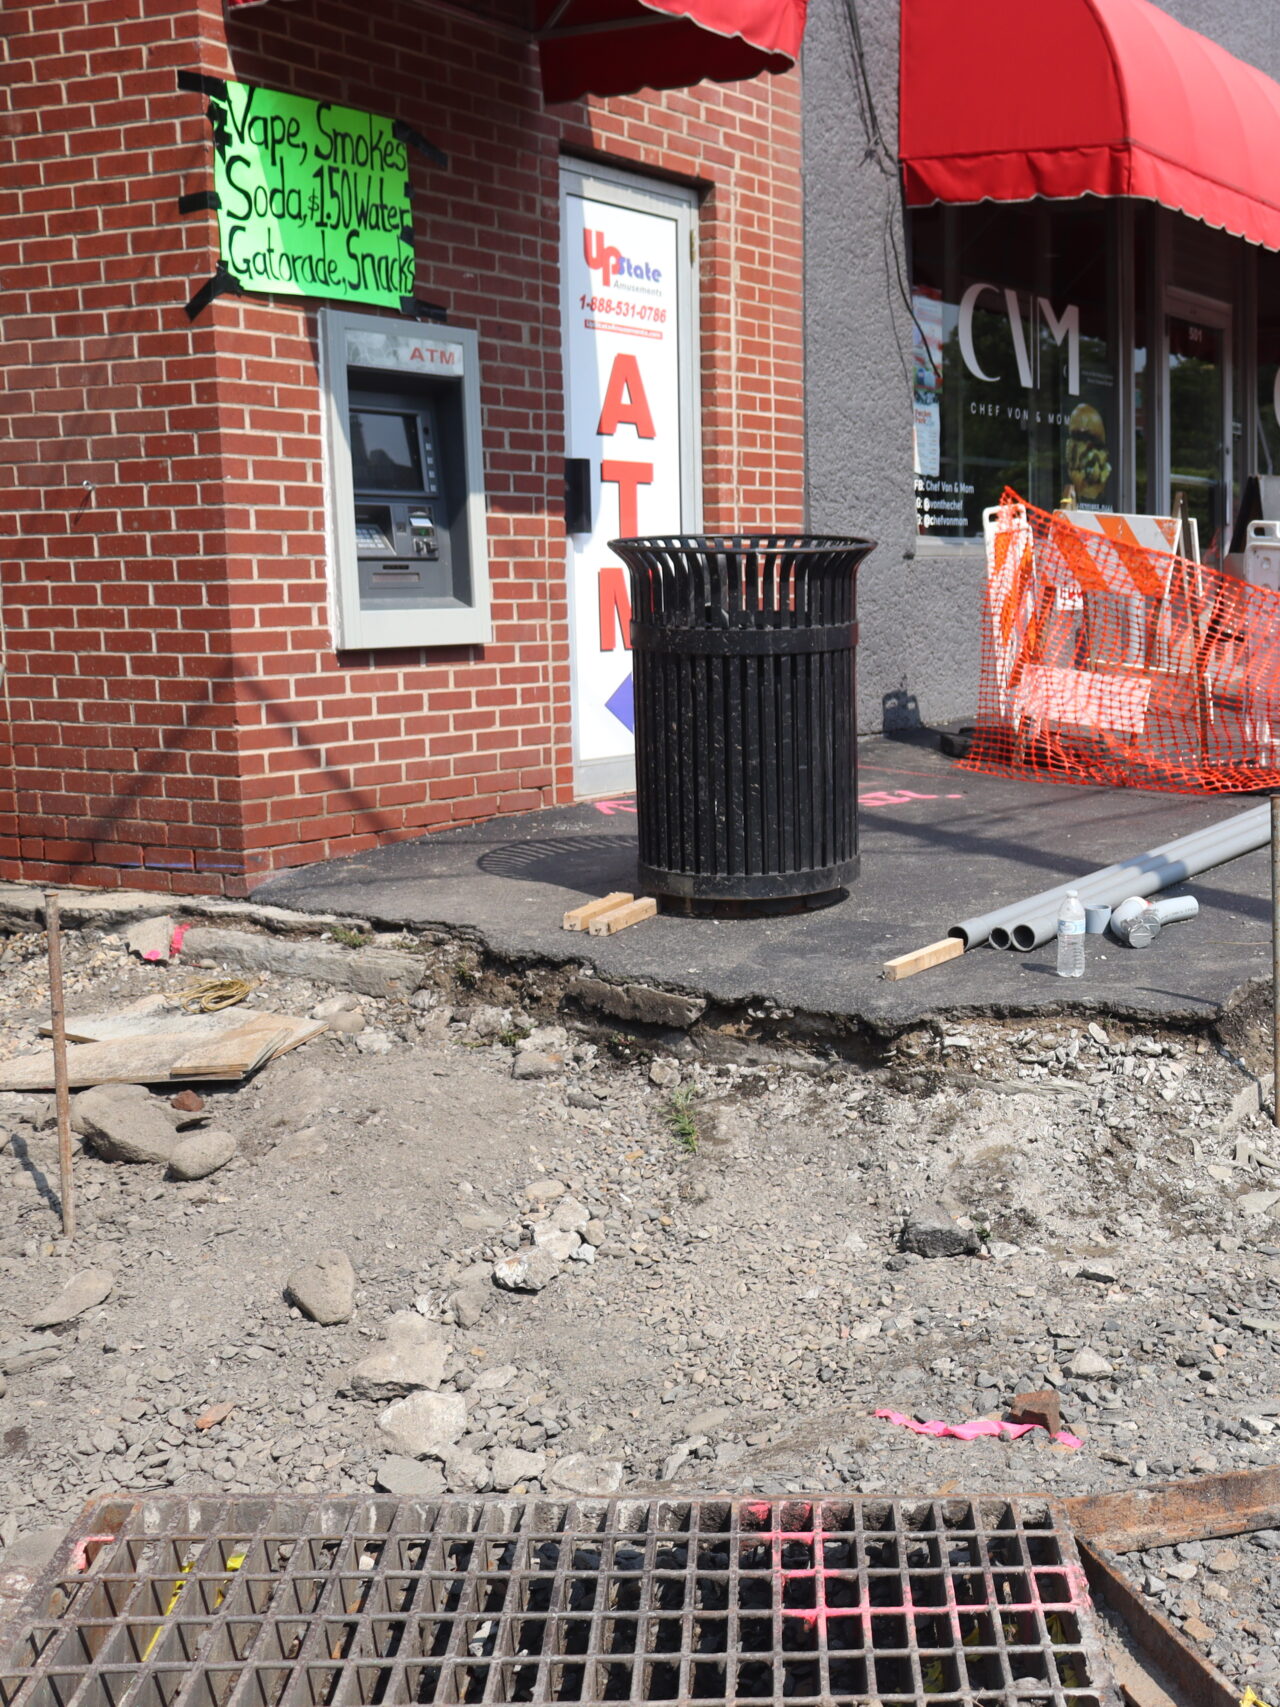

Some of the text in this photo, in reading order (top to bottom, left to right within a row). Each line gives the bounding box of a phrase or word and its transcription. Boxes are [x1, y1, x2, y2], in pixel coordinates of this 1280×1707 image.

[226, 86, 407, 172] Vape, Smokes
[225, 155, 411, 232] Soda, $1.50 Water
[228, 225, 416, 296] Gatorade, Snacks
[613, 280, 662, 297] Amusements
[579, 294, 667, 323] 1-888-531-0786
[408, 346, 456, 366] ATM
[970, 401, 1071, 425] CHEF VON & MOM
[914, 479, 926, 491] FB:
[926, 480, 940, 492] Chef
[941, 481, 953, 493] Von
